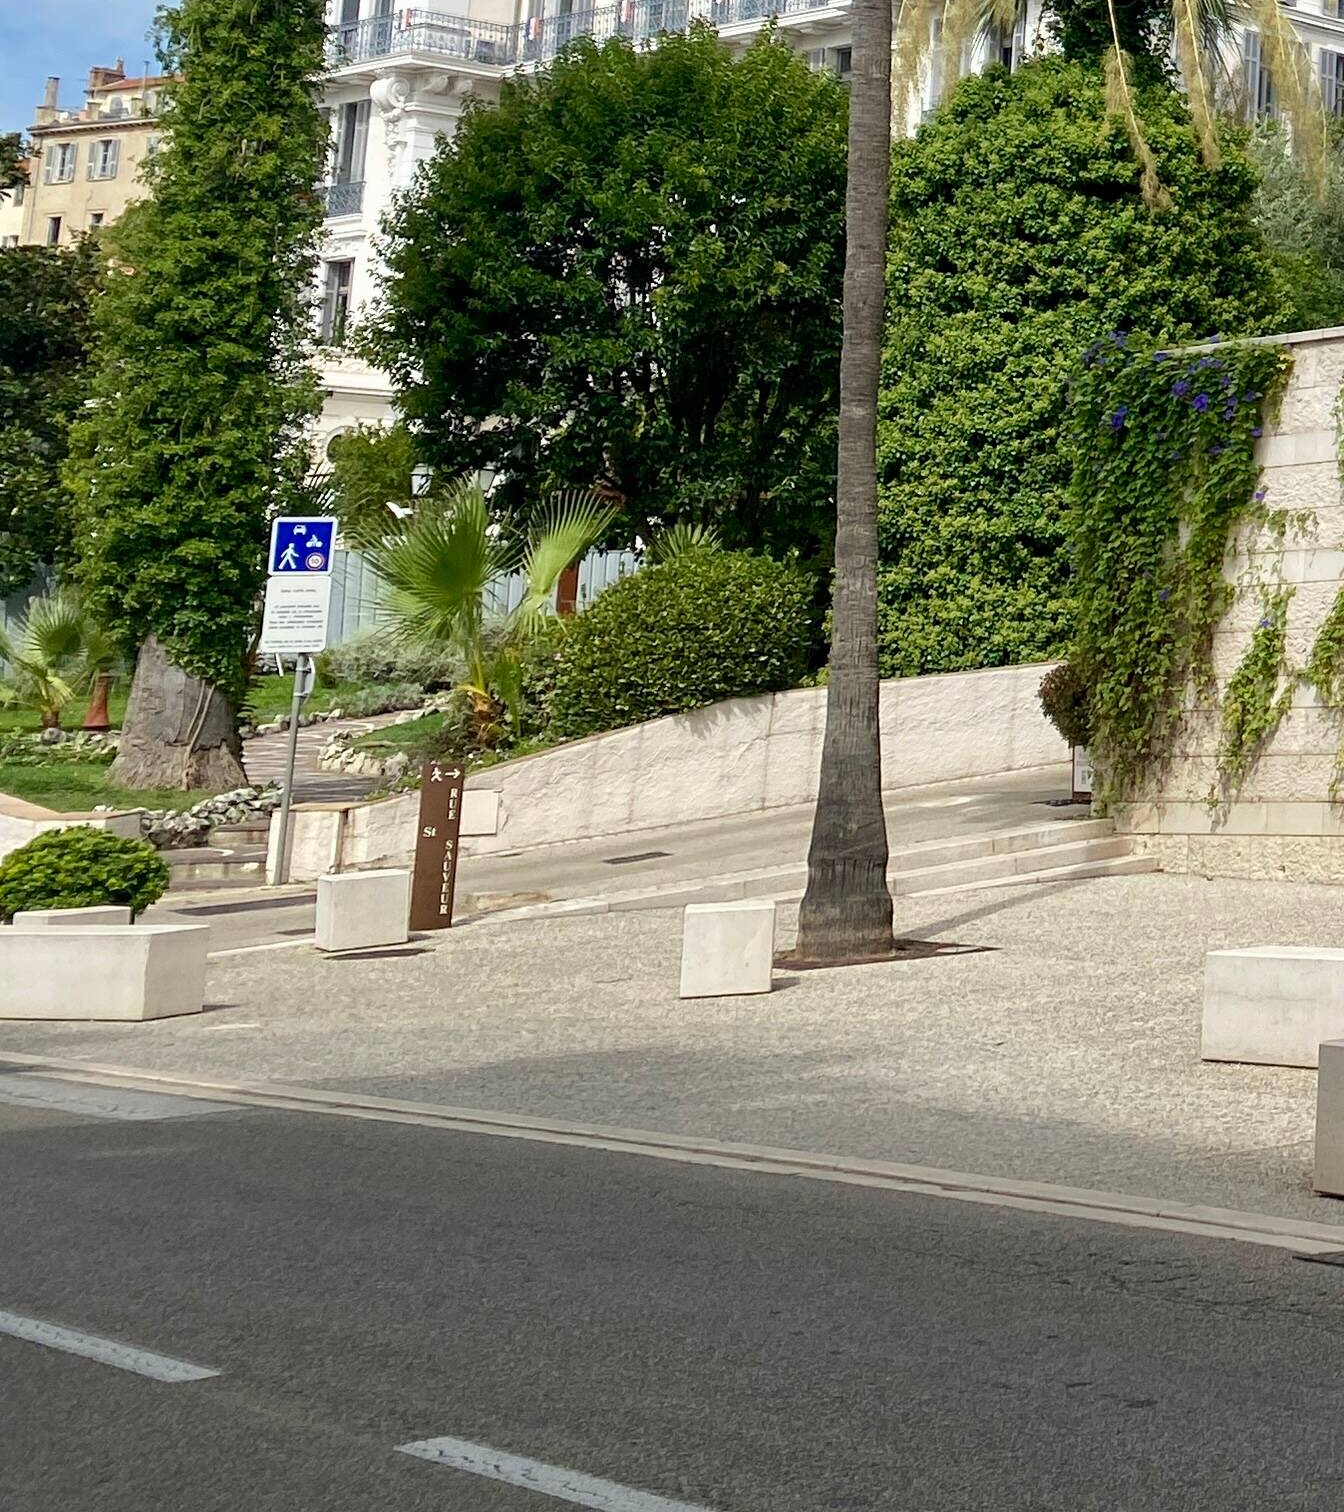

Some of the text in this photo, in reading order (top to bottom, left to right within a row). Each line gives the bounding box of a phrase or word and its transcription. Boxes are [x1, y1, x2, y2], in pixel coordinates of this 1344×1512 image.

[422, 788, 459, 915] RUE St SAUVEUR
